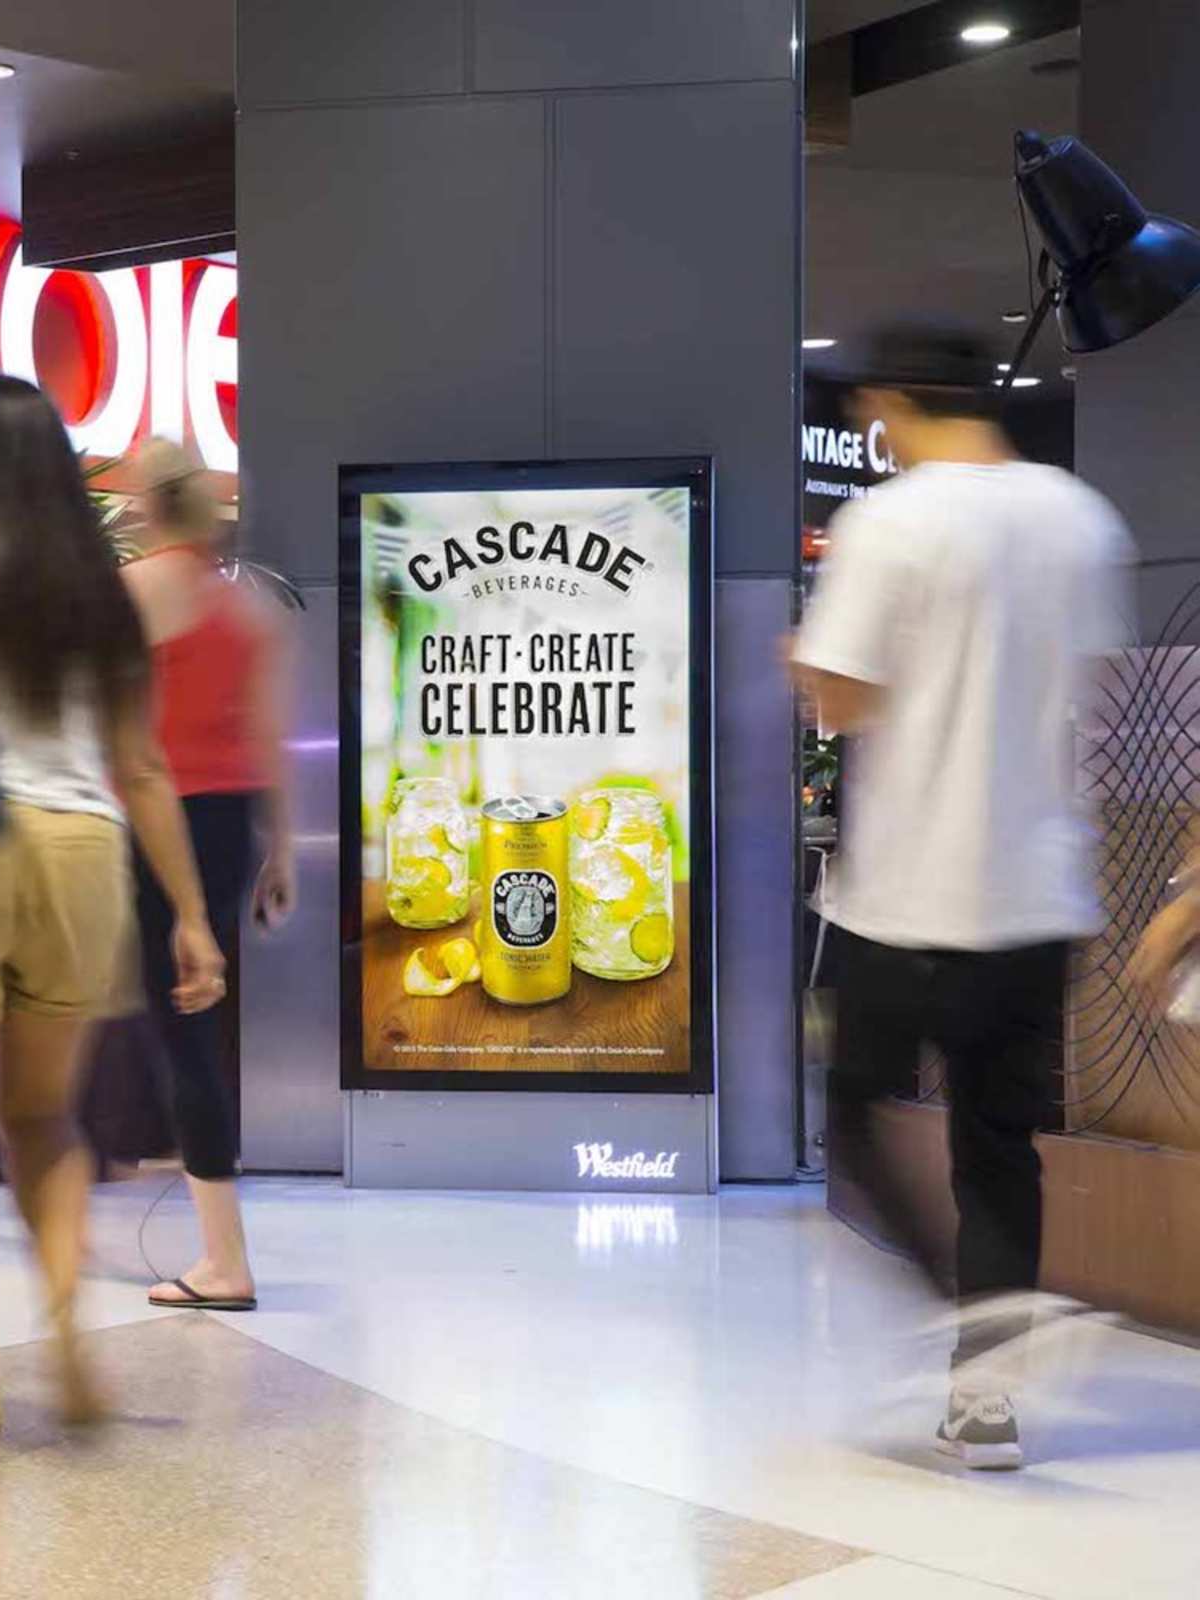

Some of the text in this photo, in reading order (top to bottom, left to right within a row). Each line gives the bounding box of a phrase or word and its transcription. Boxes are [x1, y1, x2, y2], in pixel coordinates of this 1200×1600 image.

[408, 521, 646, 592] CASCADE
[472, 575, 580, 599] BEVERAGES
[421, 681, 636, 735] CELEBRATE
[496, 874, 555, 898] CASCADE
[573, 1142, 679, 1178] Westfield
